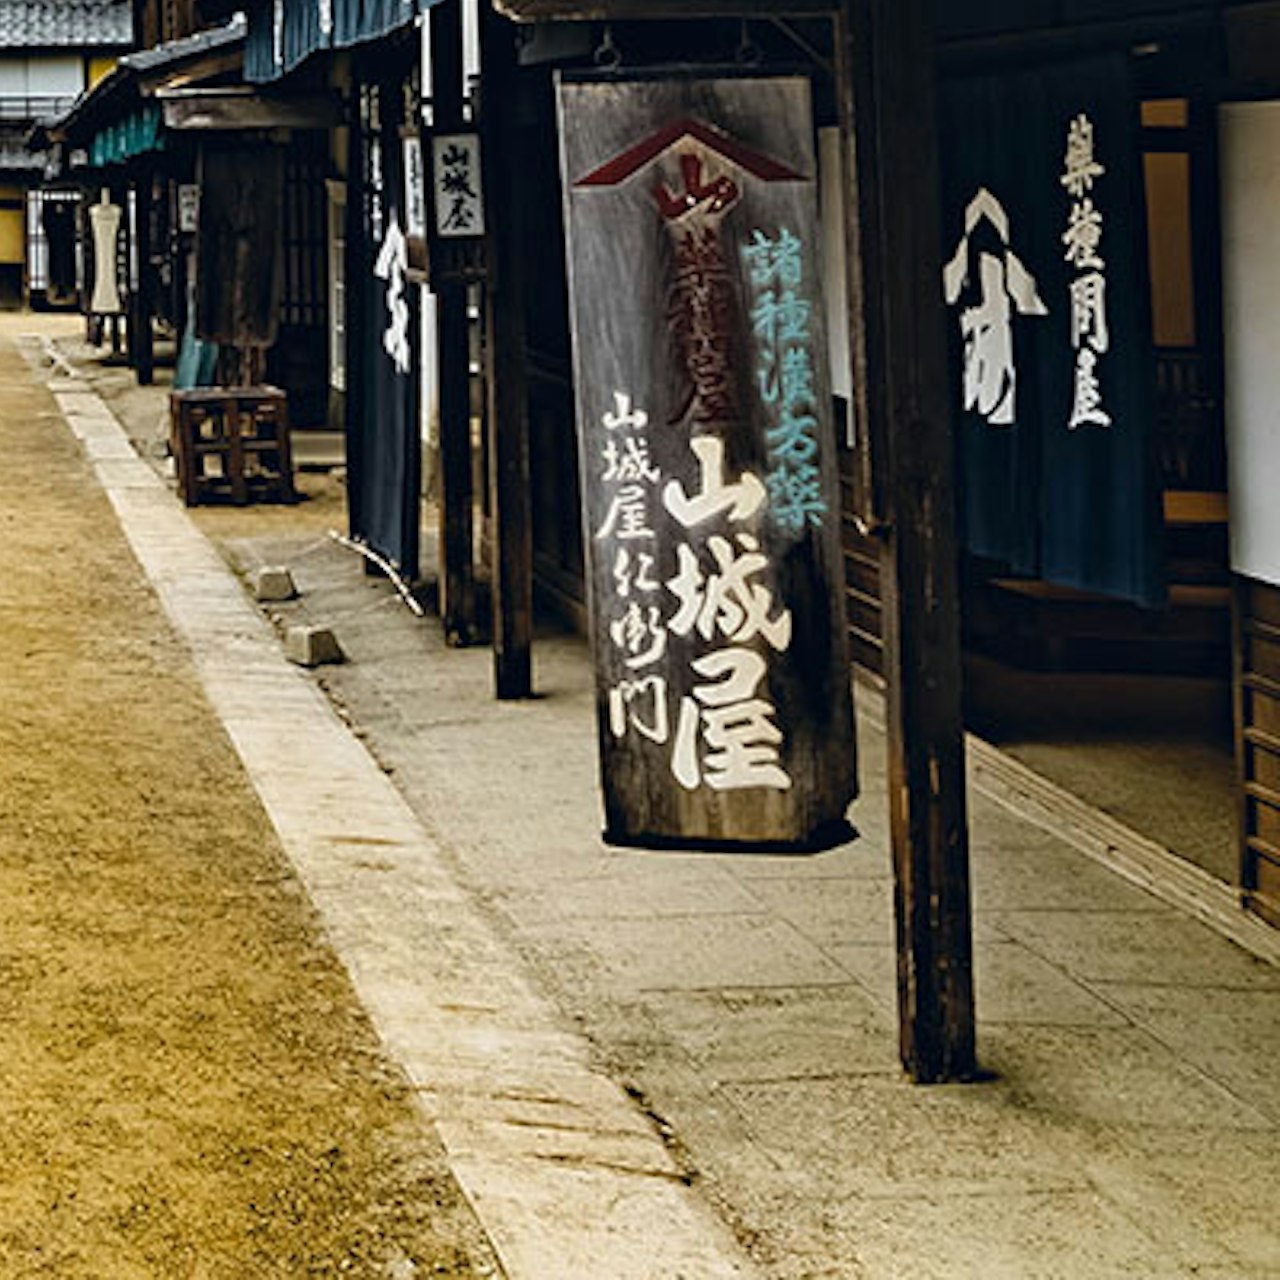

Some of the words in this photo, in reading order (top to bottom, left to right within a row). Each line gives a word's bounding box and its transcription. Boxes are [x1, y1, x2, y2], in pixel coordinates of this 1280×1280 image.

[440, 143, 477, 231] 山城屋
[662, 435, 793, 791] 山城屋
